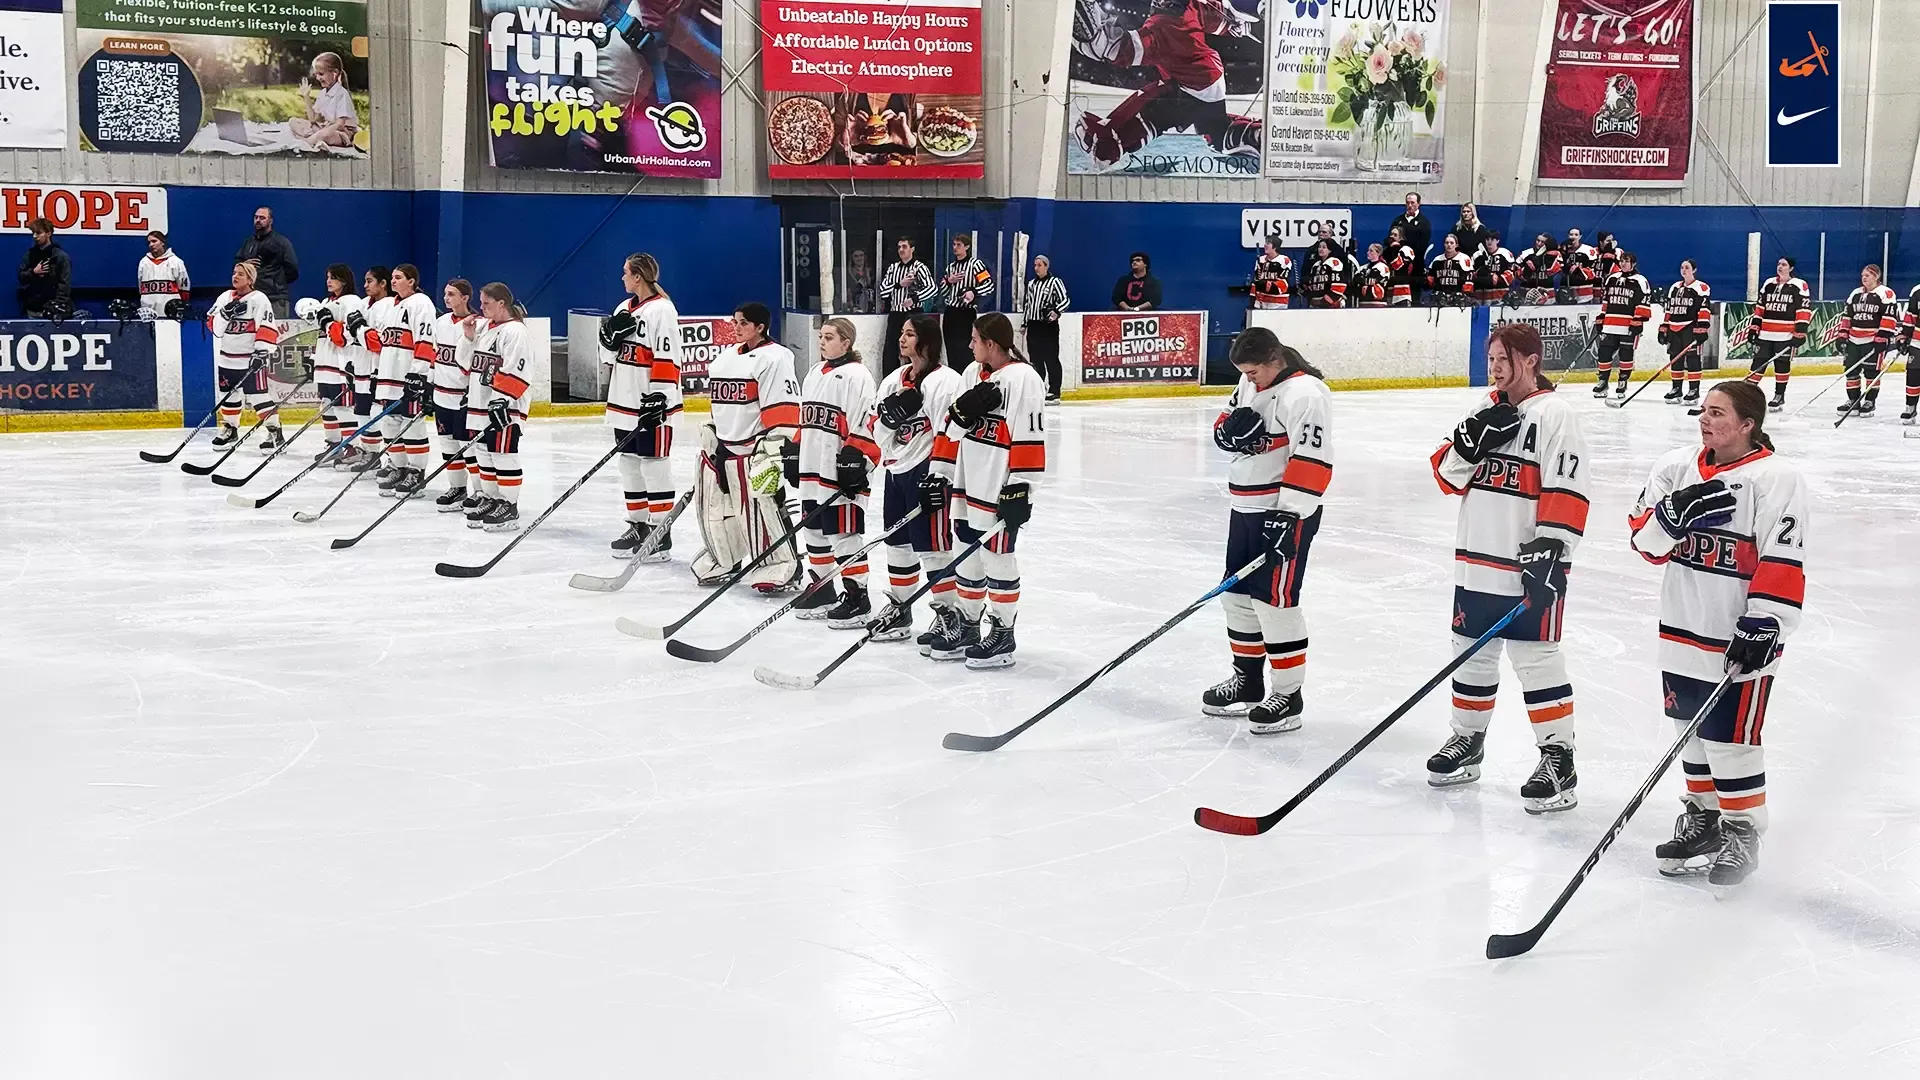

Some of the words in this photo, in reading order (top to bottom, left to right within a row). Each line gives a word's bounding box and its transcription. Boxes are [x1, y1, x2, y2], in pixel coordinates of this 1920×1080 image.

[248, 3, 276, 14] K-12
[279, 5, 336, 20] schooling
[517, 5, 608, 38] Where
[778, 7, 868, 25] Unbeatable
[872, 11, 921, 29] Happy
[925, 13, 969, 28] Hours
[1331, 0, 1437, 23] FLOWERS
[104, 10, 131, 23] that
[134, 12, 155, 24] fits
[158, 16, 186, 27] your
[248, 18, 297, 34] lifestyle
[299, 21, 308, 32] &
[311, 23, 347, 36] goals.
[1278, 21, 1325, 38] Flowers
[1557, 11, 1633, 45] LET'S
[1643, 17, 1683, 48] GO!
[110, 41, 137, 50] LEARN
[140, 42, 165, 51] MORE
[488, 12, 598, 78] fun
[773, 33, 859, 50] Affordable
[863, 36, 910, 51] Lunch
[914, 37, 973, 55] Options
[1275, 39, 1295, 59] for
[1298, 45, 1331, 61] every
[791, 59, 853, 75] Electric
[858, 61, 953, 80] Atmosphere
[1277, 58, 1327, 74] occasion
[506, 76, 595, 107] takes
[1272, 89, 1298, 103] Holland
[490, 100, 623, 137] flight
[1595, 114, 1640, 135] GRIFFINS
[1271, 125, 1291, 139] Grand
[1292, 126, 1312, 140] Haven
[604, 153, 711, 168] UrbanAirHolland.com
[1143, 155, 1179, 173] FOX
[1183, 156, 1260, 175] MOTORS
[1565, 148, 1666, 165] GRIFFINSHOCKEY.COM
[2, 188, 149, 231] HOPE
[1246, 219, 1348, 237] VISITORS
[1126, 281, 1145, 301] C
[401, 308, 409, 325] A
[419, 321, 433, 337] 20
[636, 319, 646, 338] C
[679, 324, 711, 343] RO
[1122, 319, 1158, 337] PRO
[655, 336, 671, 352] 16
[1097, 335, 1186, 357] FIREWORKS
[517, 358, 525, 372] 9
[1151, 354, 1160, 362] MI
[1085, 367, 1158, 379] PENALTY
[1162, 366, 1193, 377] BOX
[0, 382, 96, 400] HOCKEY
[711, 381, 747, 401] HOPE
[784, 379, 799, 396] 30
[1522, 422, 1537, 454] A
[1473, 457, 1522, 492] OPE
[1556, 450, 1580, 481] 17
[1774, 513, 1803, 550] 2
[1678, 531, 1738, 572] OPE
